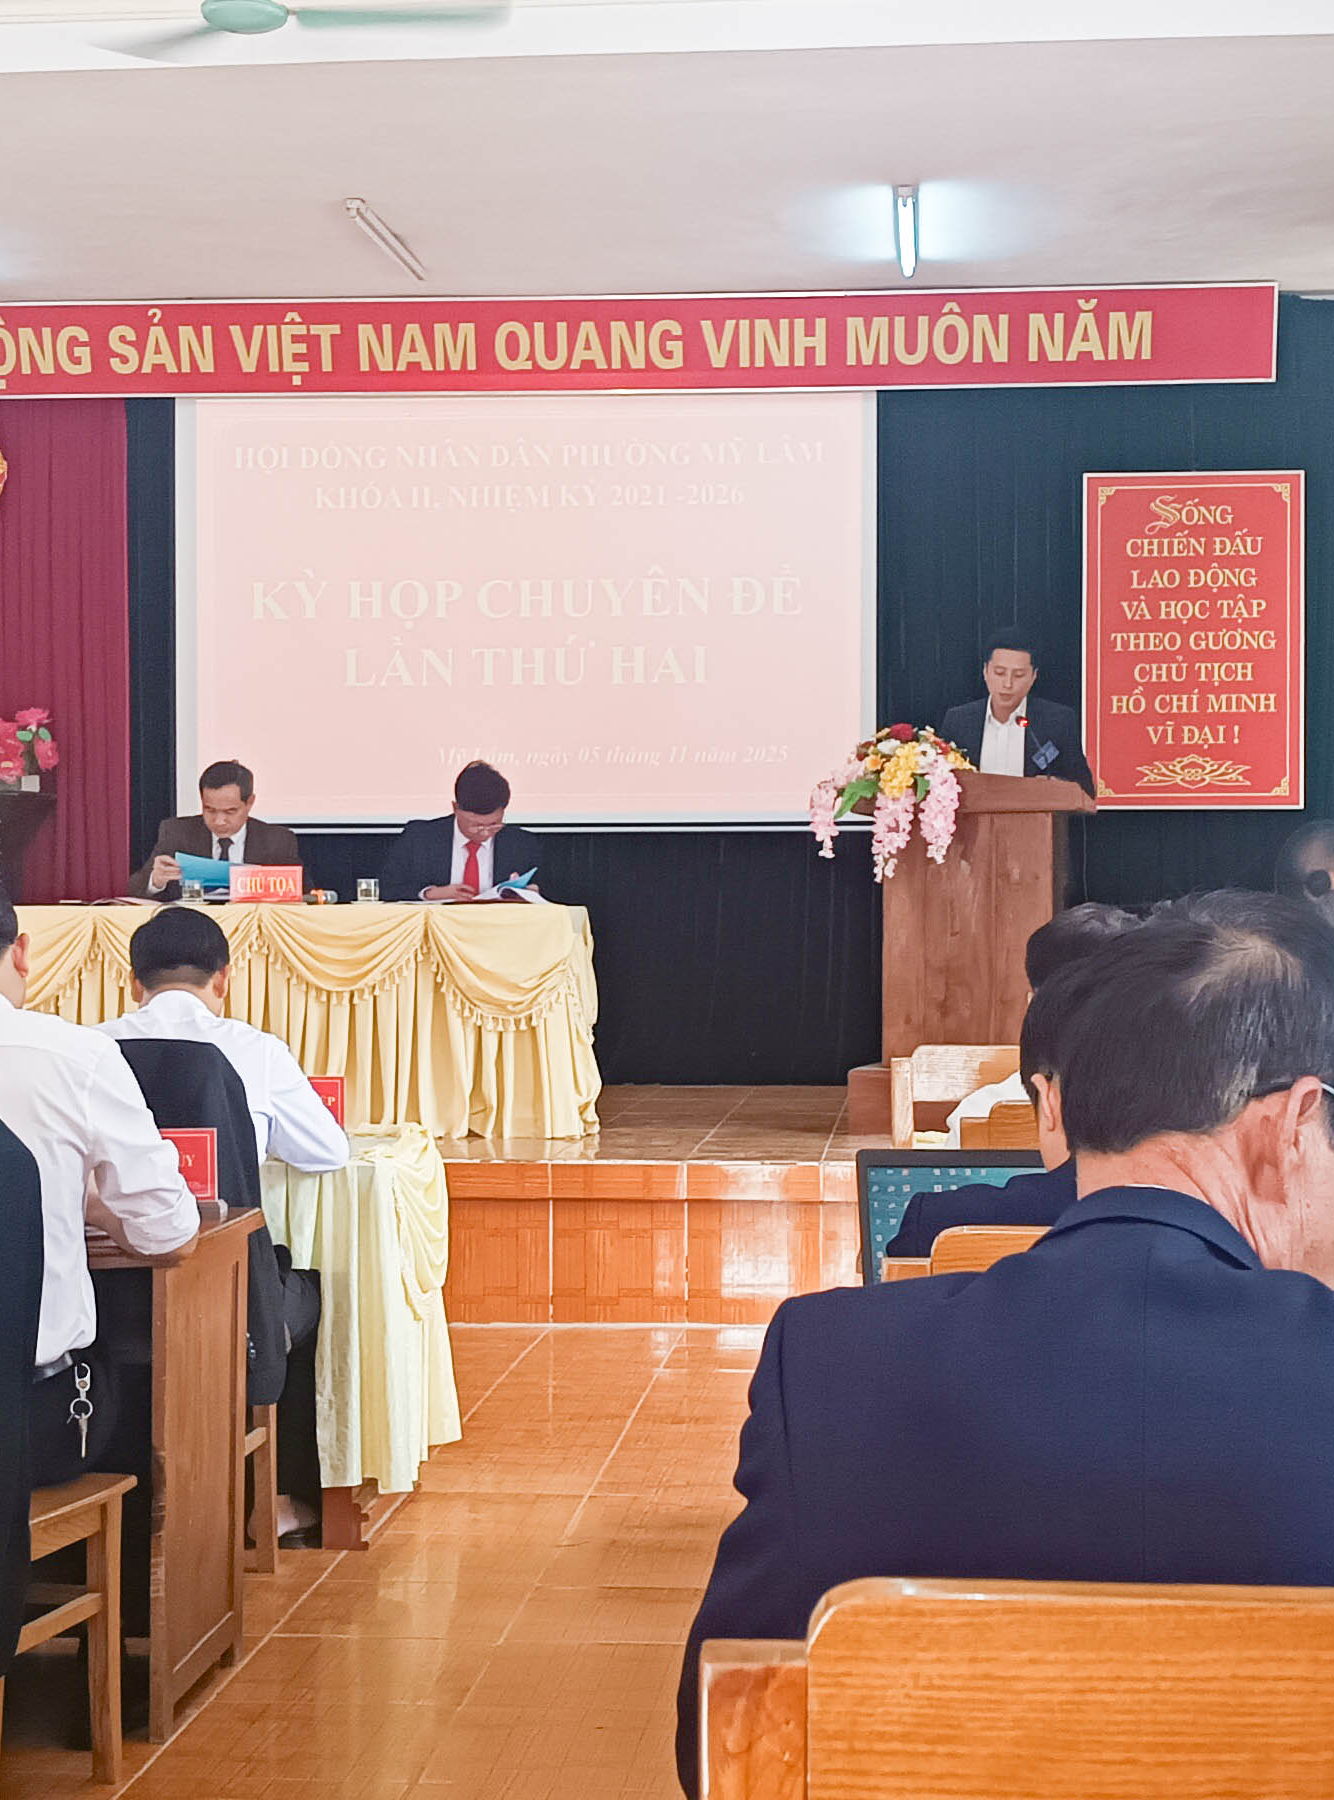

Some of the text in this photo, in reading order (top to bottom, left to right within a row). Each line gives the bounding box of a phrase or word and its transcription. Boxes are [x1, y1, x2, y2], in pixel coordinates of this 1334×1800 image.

[109, 309, 214, 374] SẢN
[234, 312, 341, 385] VIỆT
[358, 323, 476, 371] NAM
[495, 320, 683, 370] QUANG
[702, 314, 827, 368] VINH
[847, 302, 1008, 365] MUÔN
[1029, 299, 1152, 361] NĂM
[397, 438, 482, 468] NHÂN
[491, 437, 551, 467] DÂN
[758, 435, 825, 463] LÂM
[317, 481, 403, 509] KHÓA
[610, 484, 667, 507] 2021
[1145, 496, 1234, 536] SỐNG
[1127, 528, 1263, 557] CHIẾN ĐẤU
[1131, 563, 1257, 592] LAO ĐỘNG
[251, 563, 803, 631] KỲ HỌP CHUYÊN ĐỀ
[1121, 594, 1266, 624] VÀ HỌC TẬP
[1111, 628, 1276, 651] THEO GƯƠNG
[345, 634, 708, 687] LẦN THỨ HAI
[1134, 656, 1253, 686] CHỦ TỊCH
[1111, 686, 1276, 713] HỒ CHÍ MINH
[1147, 721, 1174, 744] VĨ
[578, 744, 602, 763] 05
[605, 743, 660, 767] tháng
[692, 745, 738, 763] năm
[742, 744, 788, 764] 2025
[237, 872, 295, 896] CHỦ TỌA
